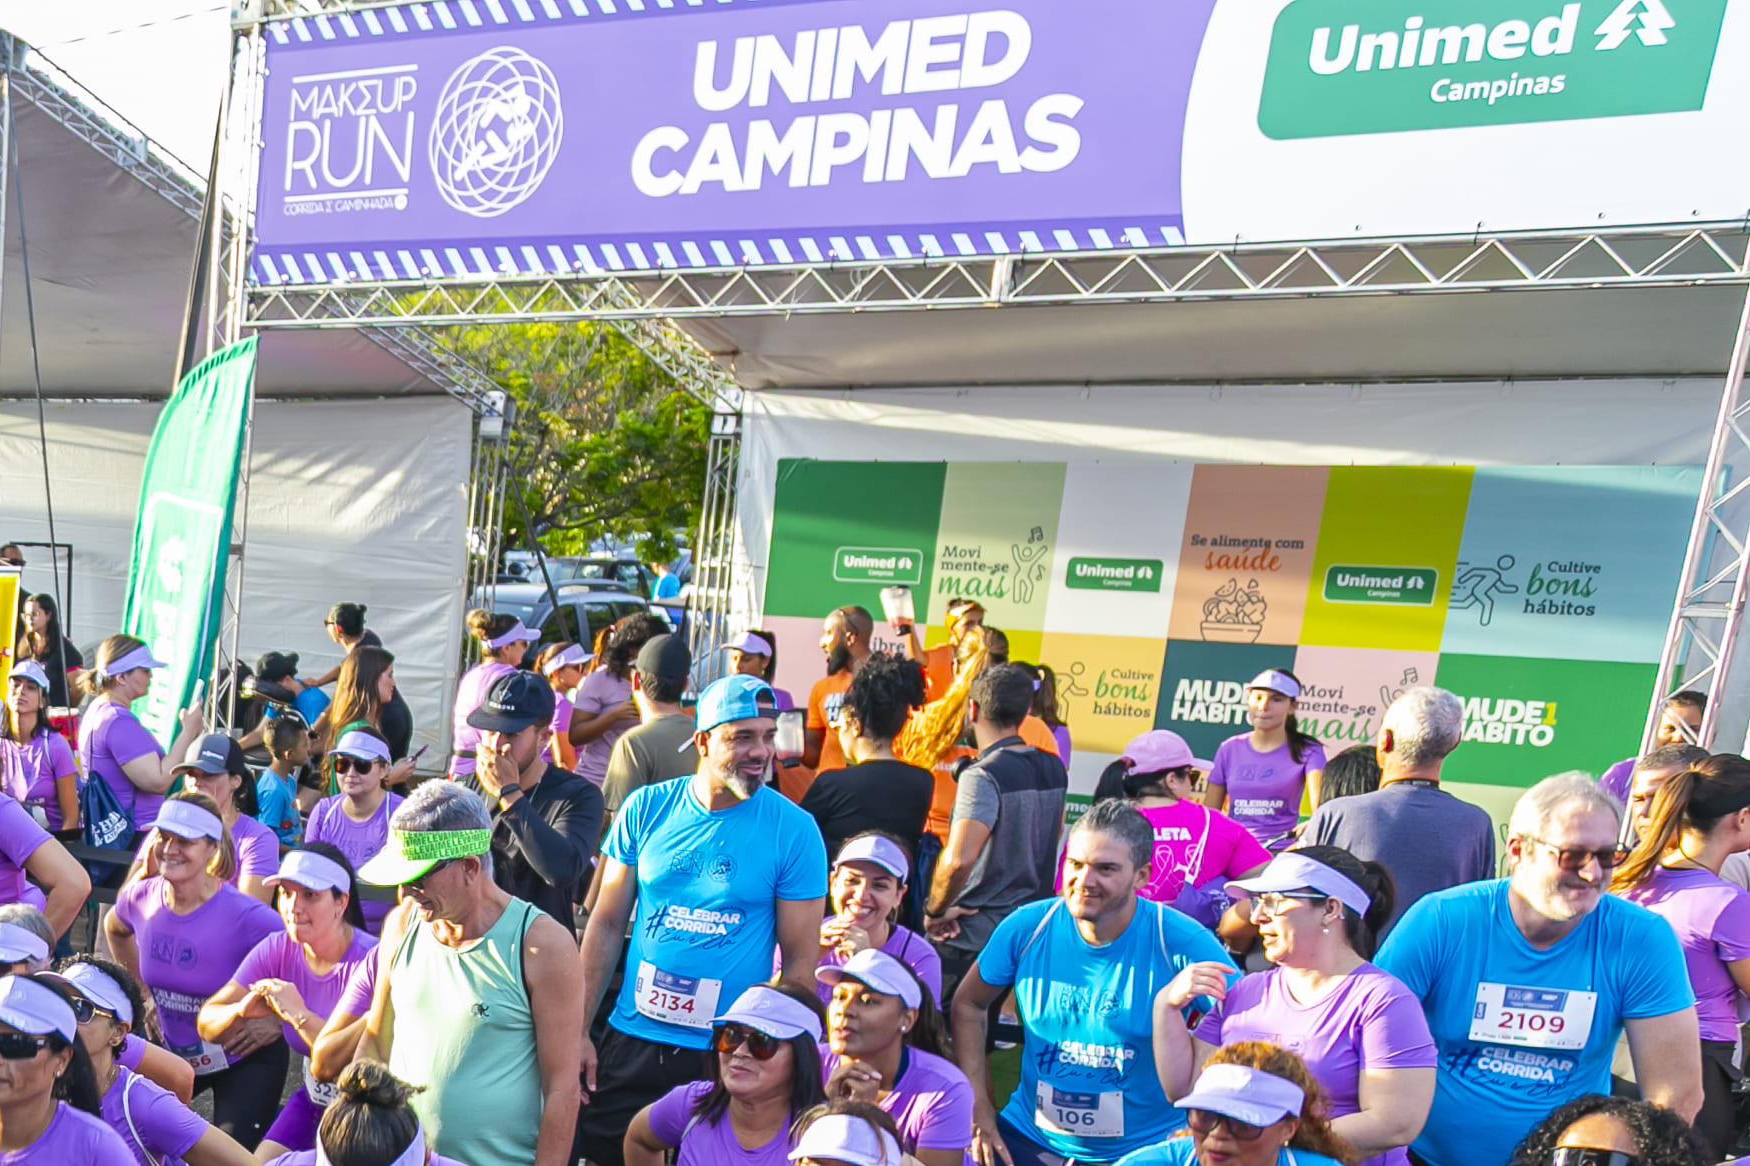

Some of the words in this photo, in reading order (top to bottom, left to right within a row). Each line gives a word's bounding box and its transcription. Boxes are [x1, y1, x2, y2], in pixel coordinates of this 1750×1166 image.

[1308, 3, 1581, 75] Unimed
[693, 9, 1033, 111] UNIMED
[1429, 72, 1566, 104] Campinas
[284, 111, 415, 191] RUN
[630, 92, 1085, 198] CAMPINAS
[1191, 534, 1207, 546] Se
[1210, 536, 1272, 550] alimente
[1275, 539, 1304, 549] com
[843, 554, 896, 569] Unimed
[942, 545, 982, 559] Movi
[1205, 546, 1282, 572] saúde
[940, 560, 1010, 573] mente-se
[1075, 563, 1134, 579] Unimed
[1547, 561, 1601, 574] Cultive
[937, 569, 1010, 598] mais
[1336, 573, 1403, 589] Unimed
[1526, 563, 1598, 598] bons
[1523, 599, 1596, 617] hábitos
[1111, 669, 1154, 680] Cultive
[1094, 670, 1149, 701] bons
[1300, 685, 1344, 699] Movi
[1092, 700, 1151, 718] hábitos
[1234, 799, 1284, 809] CELEBRAR
[1234, 807, 1275, 815] CORRIDA
[668, 905, 740, 925] CELEBRAR
[664, 916, 727, 936] CORRIDA
[648, 990, 695, 1014] 2134
[1498, 1011, 1565, 1033] 2109
[1060, 1041, 1134, 1060] CELEBRAR
[1482, 1047, 1574, 1072] CELEBRAR
[1059, 1052, 1125, 1070] CORRIDA
[1478, 1057, 1555, 1083] CORRIDA
[1057, 1108, 1095, 1126] 106
